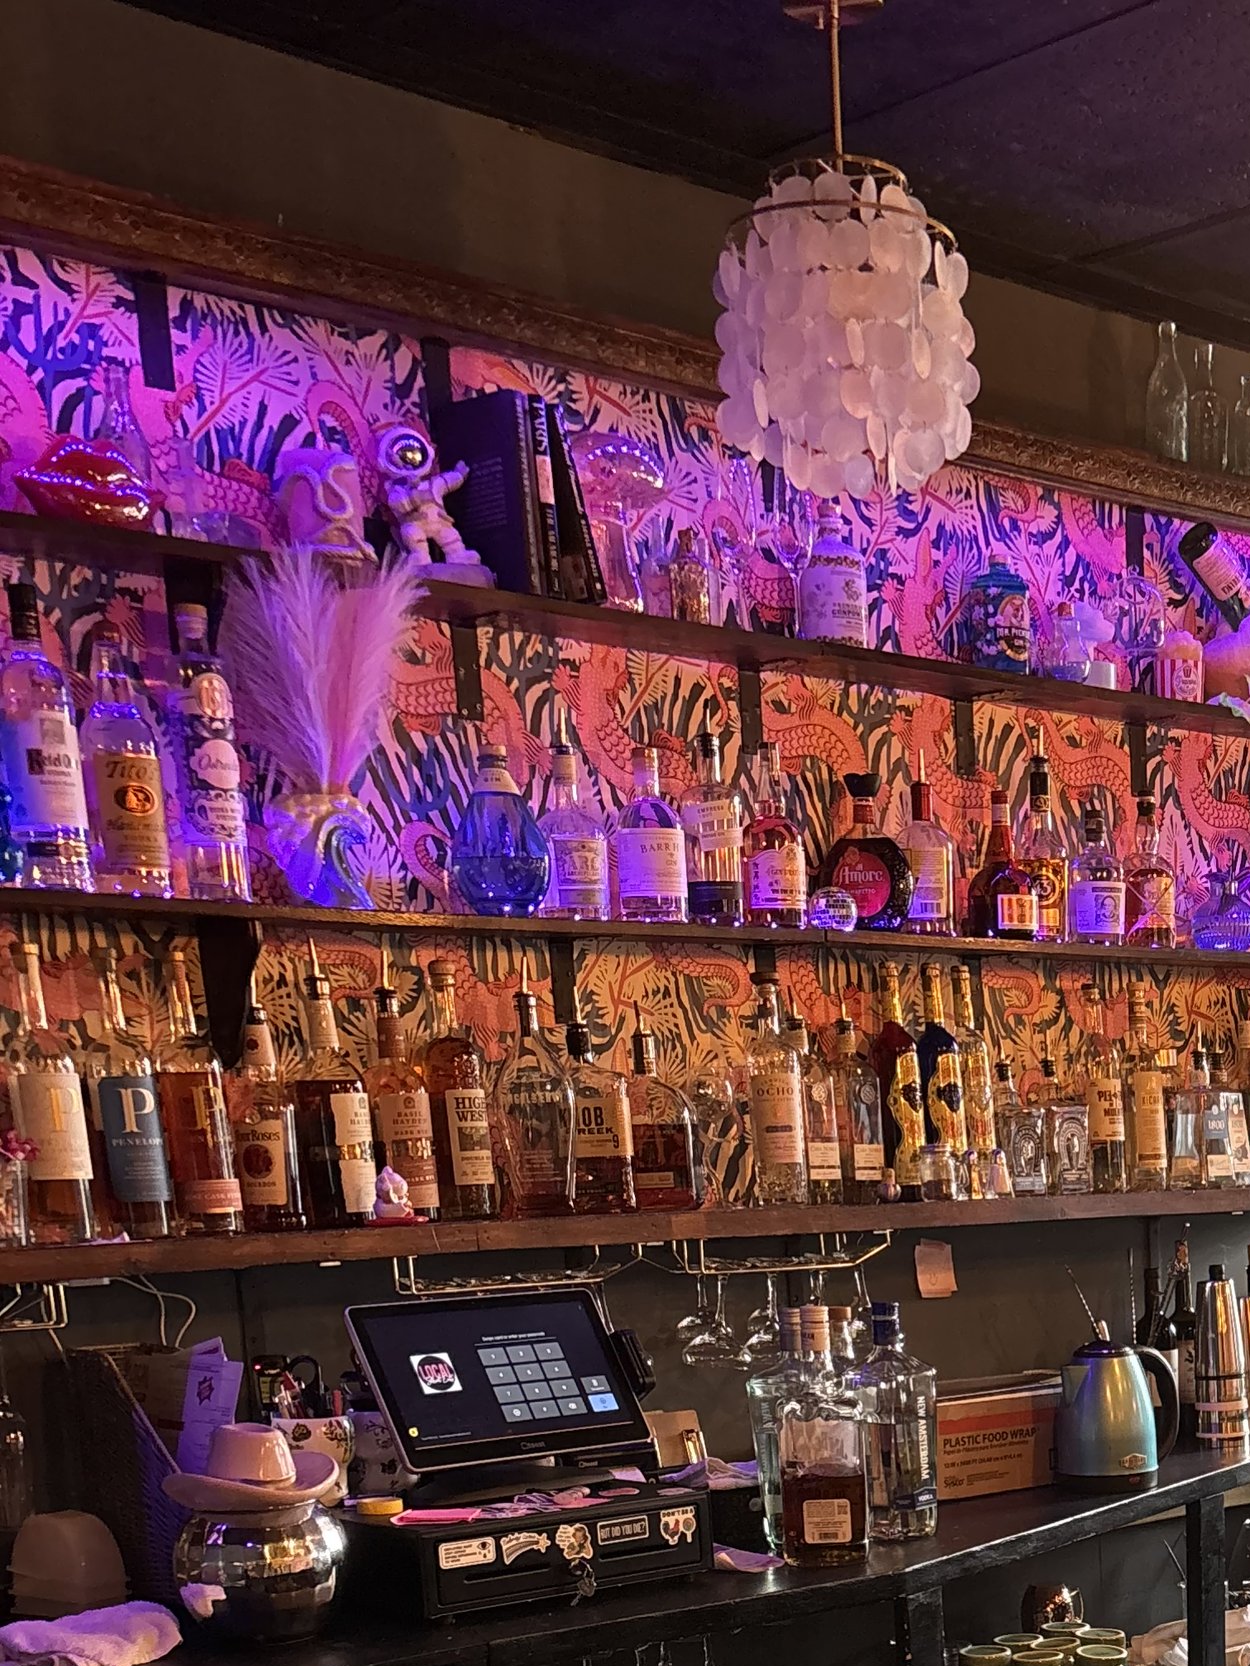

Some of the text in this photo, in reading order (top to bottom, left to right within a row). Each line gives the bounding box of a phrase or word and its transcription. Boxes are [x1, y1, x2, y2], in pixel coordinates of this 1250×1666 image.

[532, 402, 548, 452] PARIS
[756, 1086, 794, 1097] OCHO
[48, 1087, 80, 1133] P
[115, 1087, 155, 1133] P
[559, 1106, 605, 1128] KOB
[1208, 1119, 1225, 1130] 1800
[111, 1137, 164, 1147] PENELOP
[250, 1129, 281, 1142] Roses
[612, 1133, 620, 1149] 9
[418, 1363, 453, 1381] LOCAL
[917, 1395, 930, 1480] NEW AMSTERDAM
[943, 1427, 1037, 1450] PLASTIC FOOD WRAP
[611, 1525, 621, 1538] DID
[621, 1523, 632, 1535] YOU
[632, 1520, 646, 1534] DIE?
